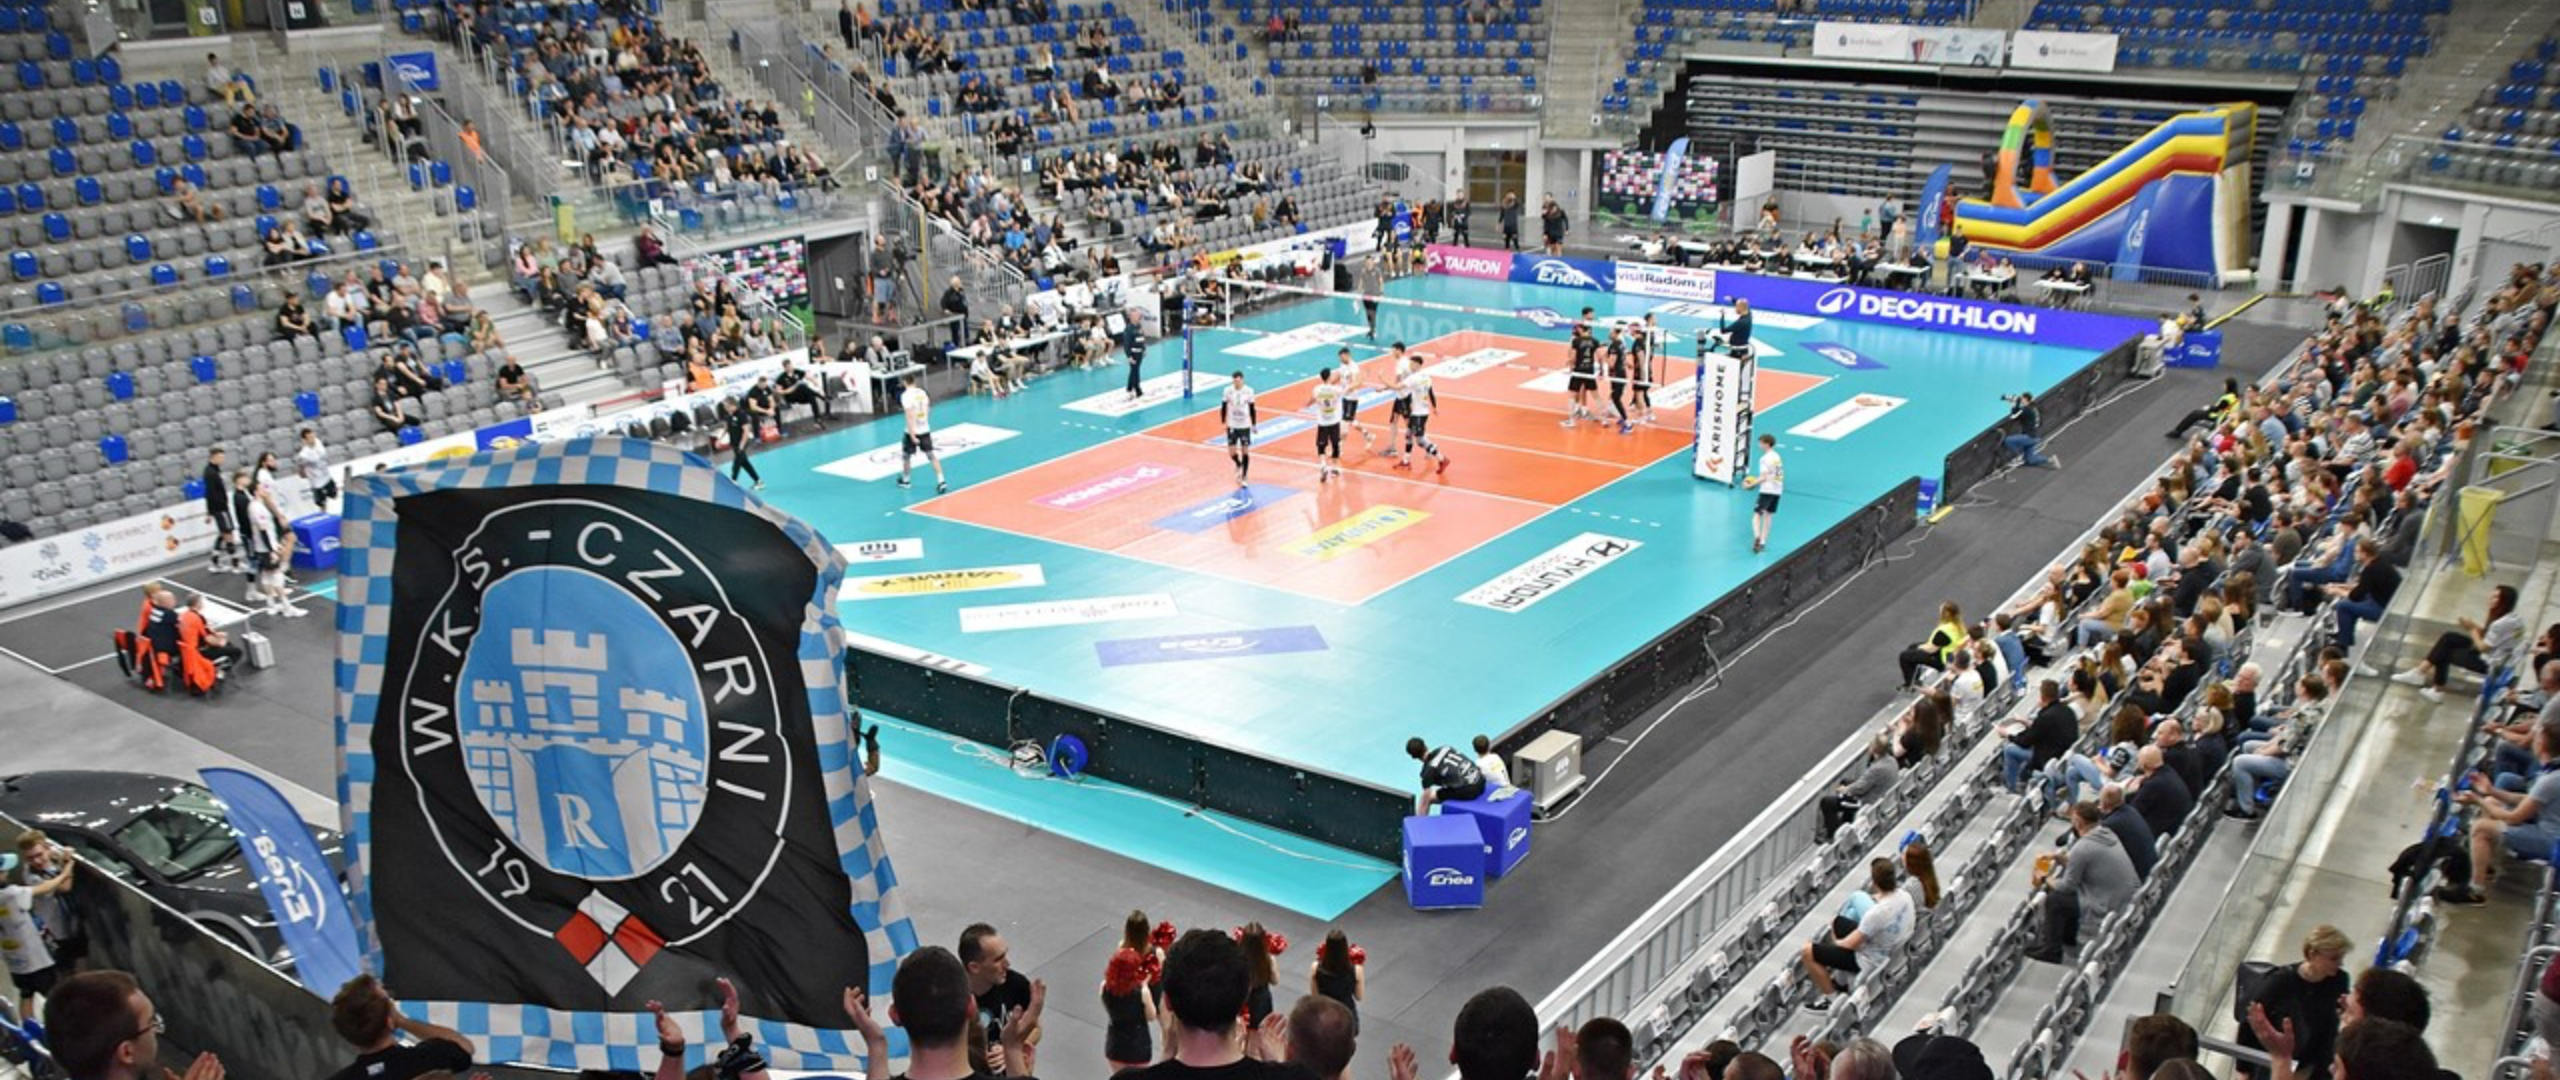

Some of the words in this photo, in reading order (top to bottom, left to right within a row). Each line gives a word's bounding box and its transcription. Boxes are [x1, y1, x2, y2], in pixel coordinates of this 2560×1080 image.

[1443, 255, 1501, 276] TAURON
[1536, 266, 1585, 287] Enea
[1617, 271, 1713, 291] visitRadom.pl
[1859, 293, 2037, 335] DECATHLON
[1711, 364, 1726, 455] KRISHOME
[1488, 557, 1597, 609] HYUNDAI
[1159, 635, 1244, 650] Enea
[554, 793, 609, 850] R
[252, 834, 313, 923] Enea
[659, 861, 730, 926] 21
[1430, 873, 1475, 886] Enea
